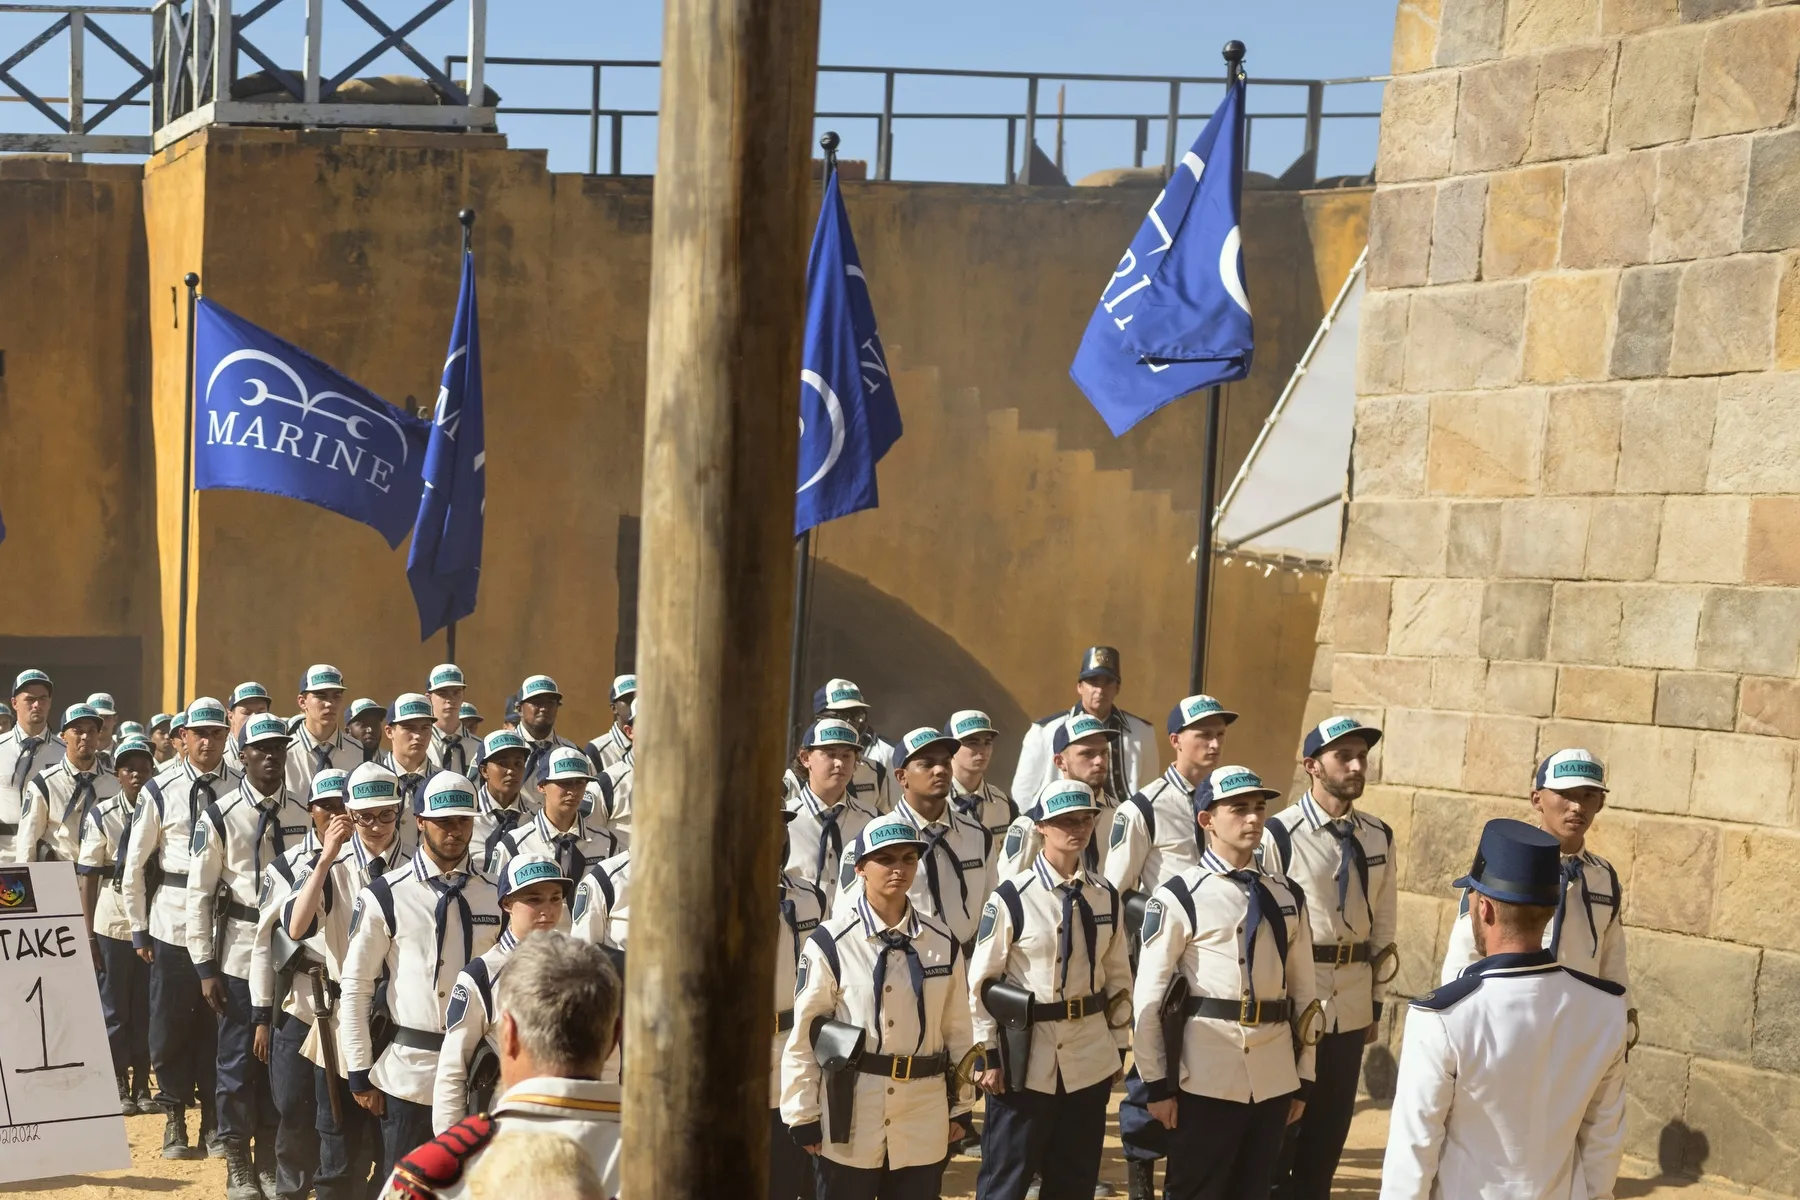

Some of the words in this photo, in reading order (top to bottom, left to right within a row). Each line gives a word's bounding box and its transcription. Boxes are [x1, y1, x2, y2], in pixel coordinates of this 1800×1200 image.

[206, 410, 394, 493] MARINE
[1560, 764, 1600, 774] MARINE
[320, 780, 344, 788] MARI
[358, 785, 392, 794] MARINE
[434, 794, 471, 806] MARINE
[1050, 794, 1089, 806] MARINE
[875, 826, 914, 838] MARINE
[519, 866, 558, 878] MARINE
[926, 966, 949, 976] MARINE
[15, 976, 85, 1074] 1
